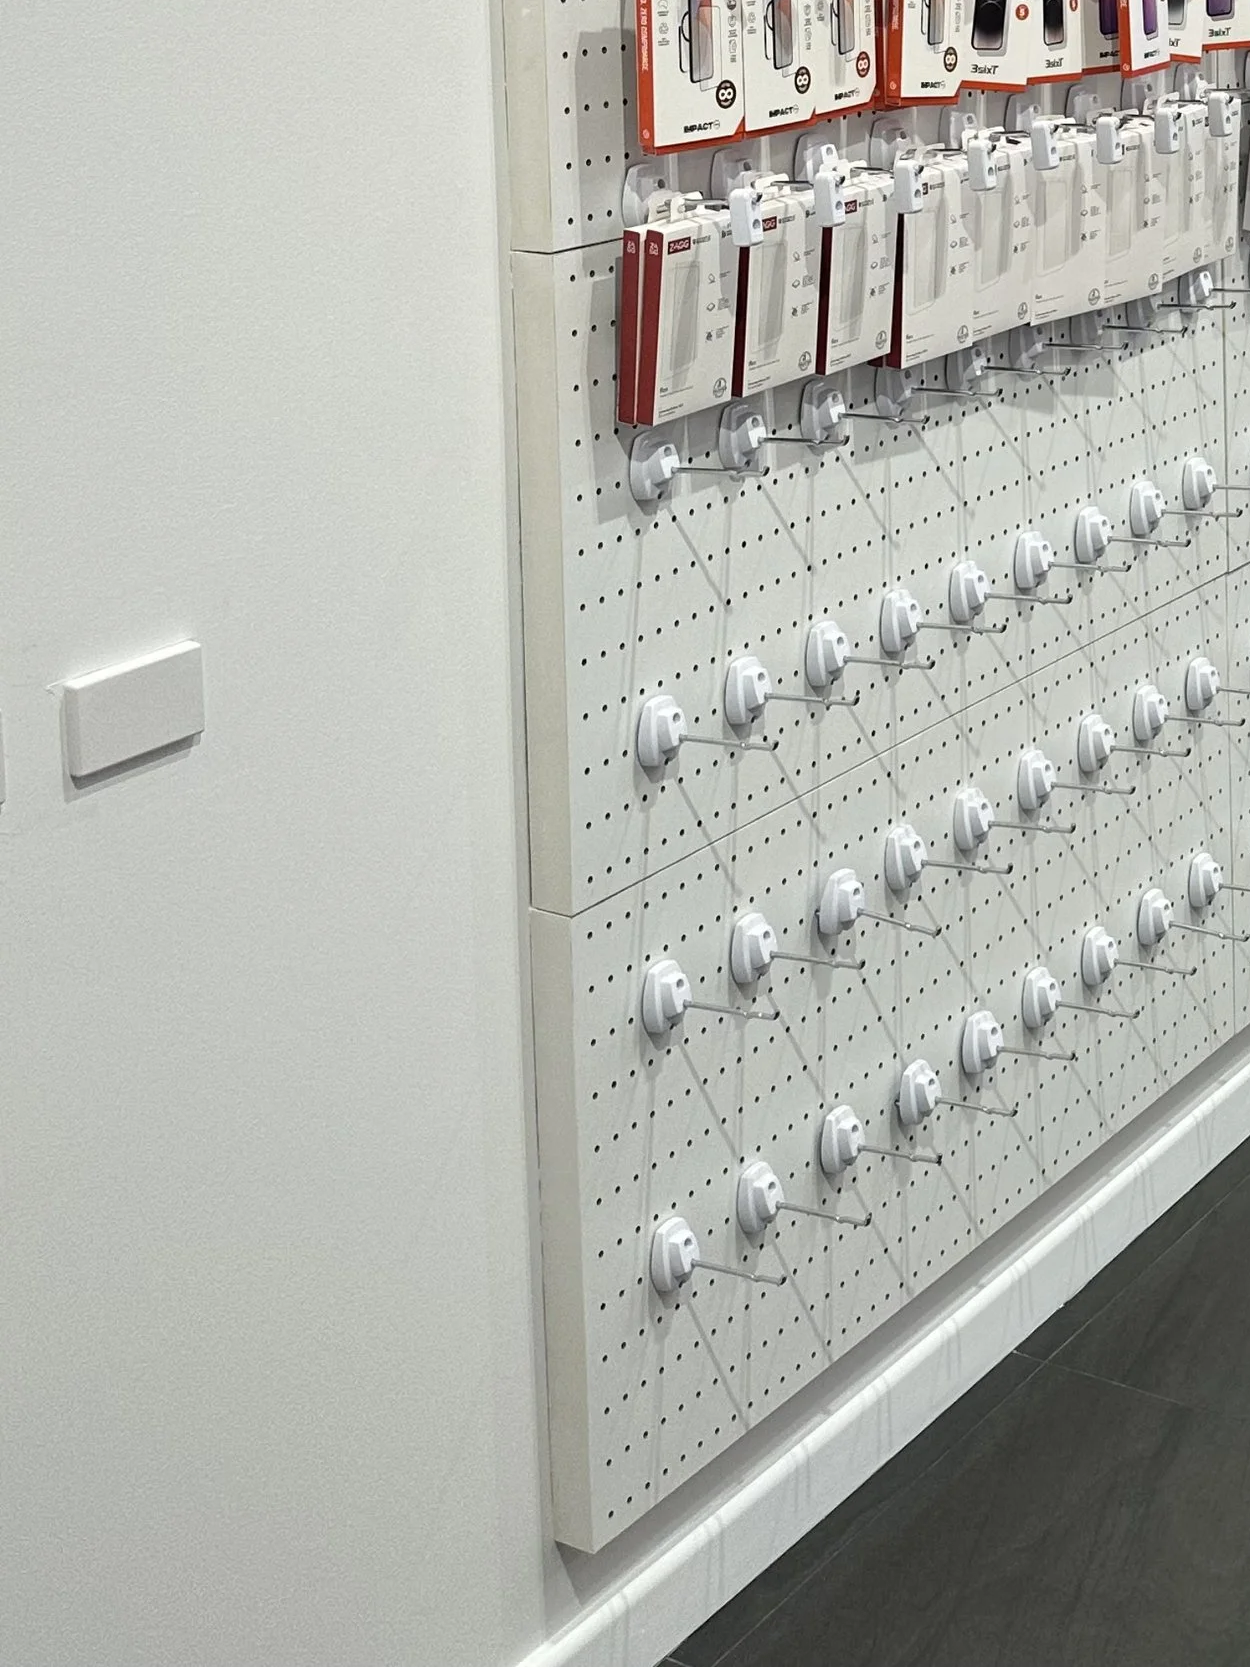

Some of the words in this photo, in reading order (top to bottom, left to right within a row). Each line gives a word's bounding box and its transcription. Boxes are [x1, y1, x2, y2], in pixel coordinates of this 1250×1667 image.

[971, 64, 999, 75] 3sixT
[768, 106, 793, 118] IMPACT
[683, 121, 713, 134] IMPACT
[669, 240, 690, 252] ZAGG
